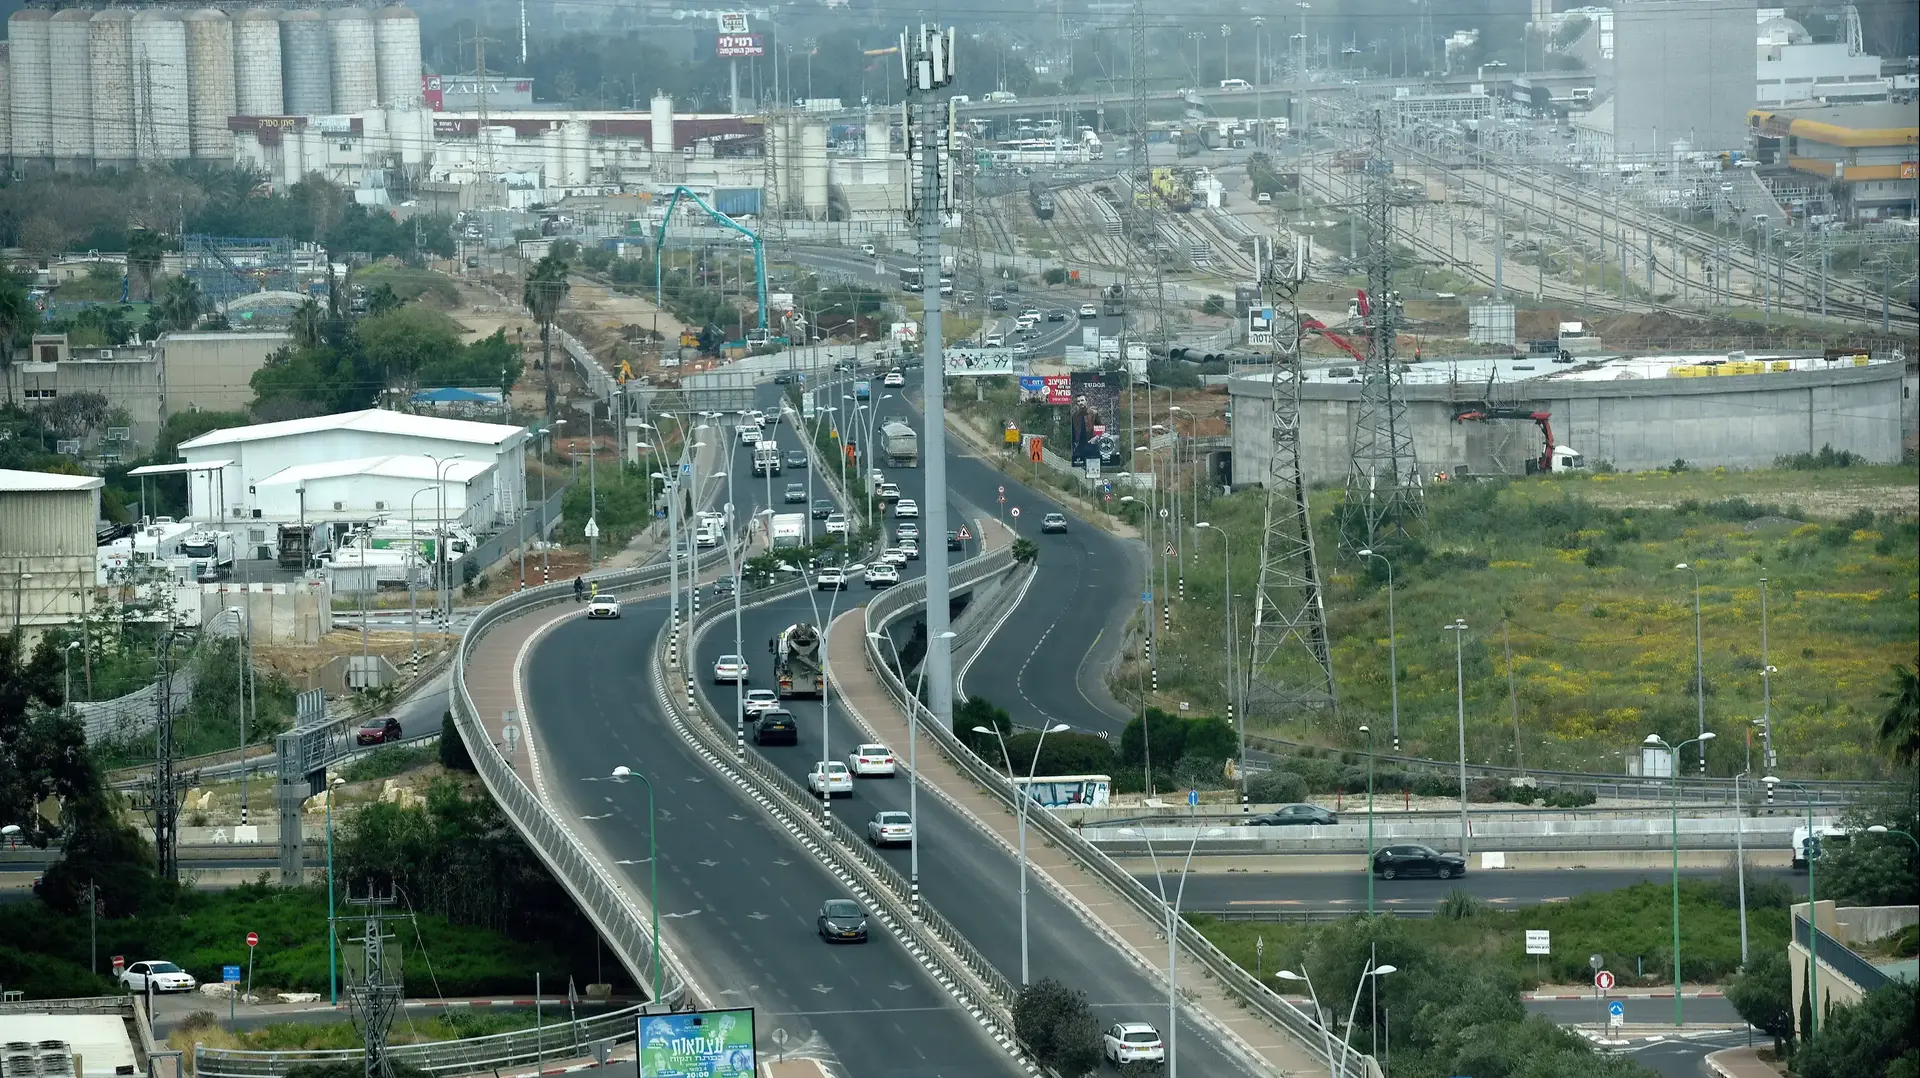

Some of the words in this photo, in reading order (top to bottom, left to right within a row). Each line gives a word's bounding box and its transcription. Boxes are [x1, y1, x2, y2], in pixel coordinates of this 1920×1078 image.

[720, 36, 733, 47] לוי
[735, 36, 752, 46] רמי
[445, 84, 500, 94] ZARA
[672, 1036, 724, 1056] עצמאות
